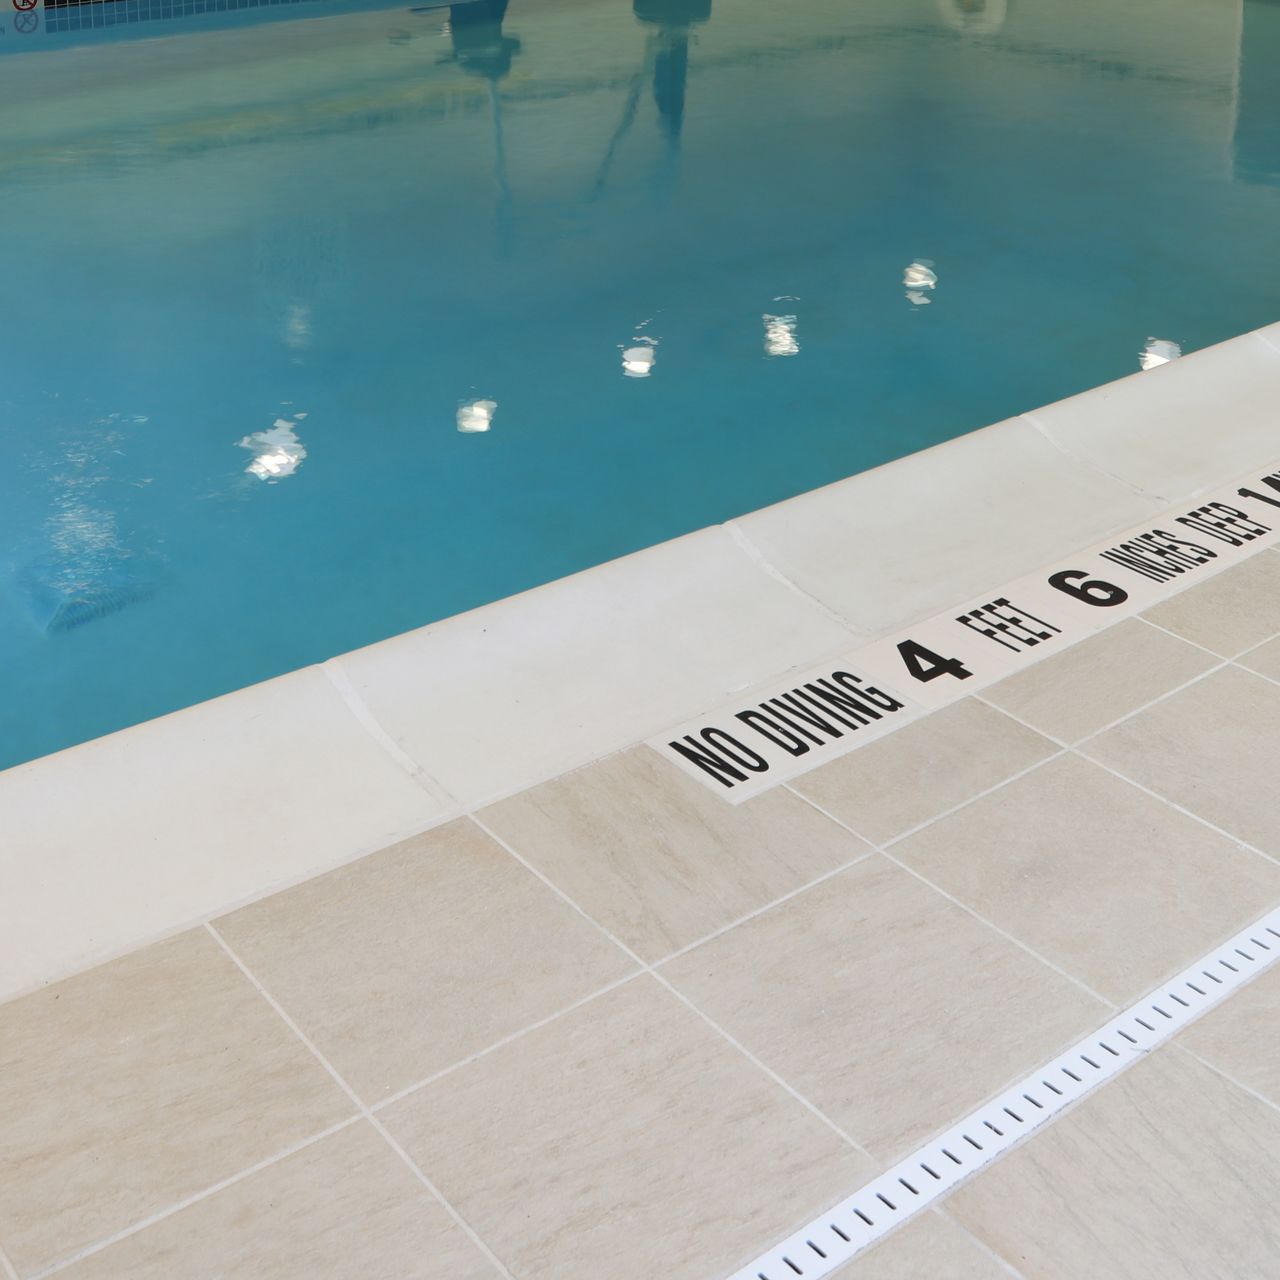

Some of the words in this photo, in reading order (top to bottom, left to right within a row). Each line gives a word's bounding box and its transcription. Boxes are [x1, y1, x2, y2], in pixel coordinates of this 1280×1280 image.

[668, 727, 770, 788] NO
[734, 671, 904, 757] DIVING
[897, 639, 974, 683] 4
[955, 597, 1062, 652] FEET
[1047, 570, 1128, 607] 6
[1099, 529, 1218, 583] INCHES
[1175, 502, 1272, 547] DEEP
